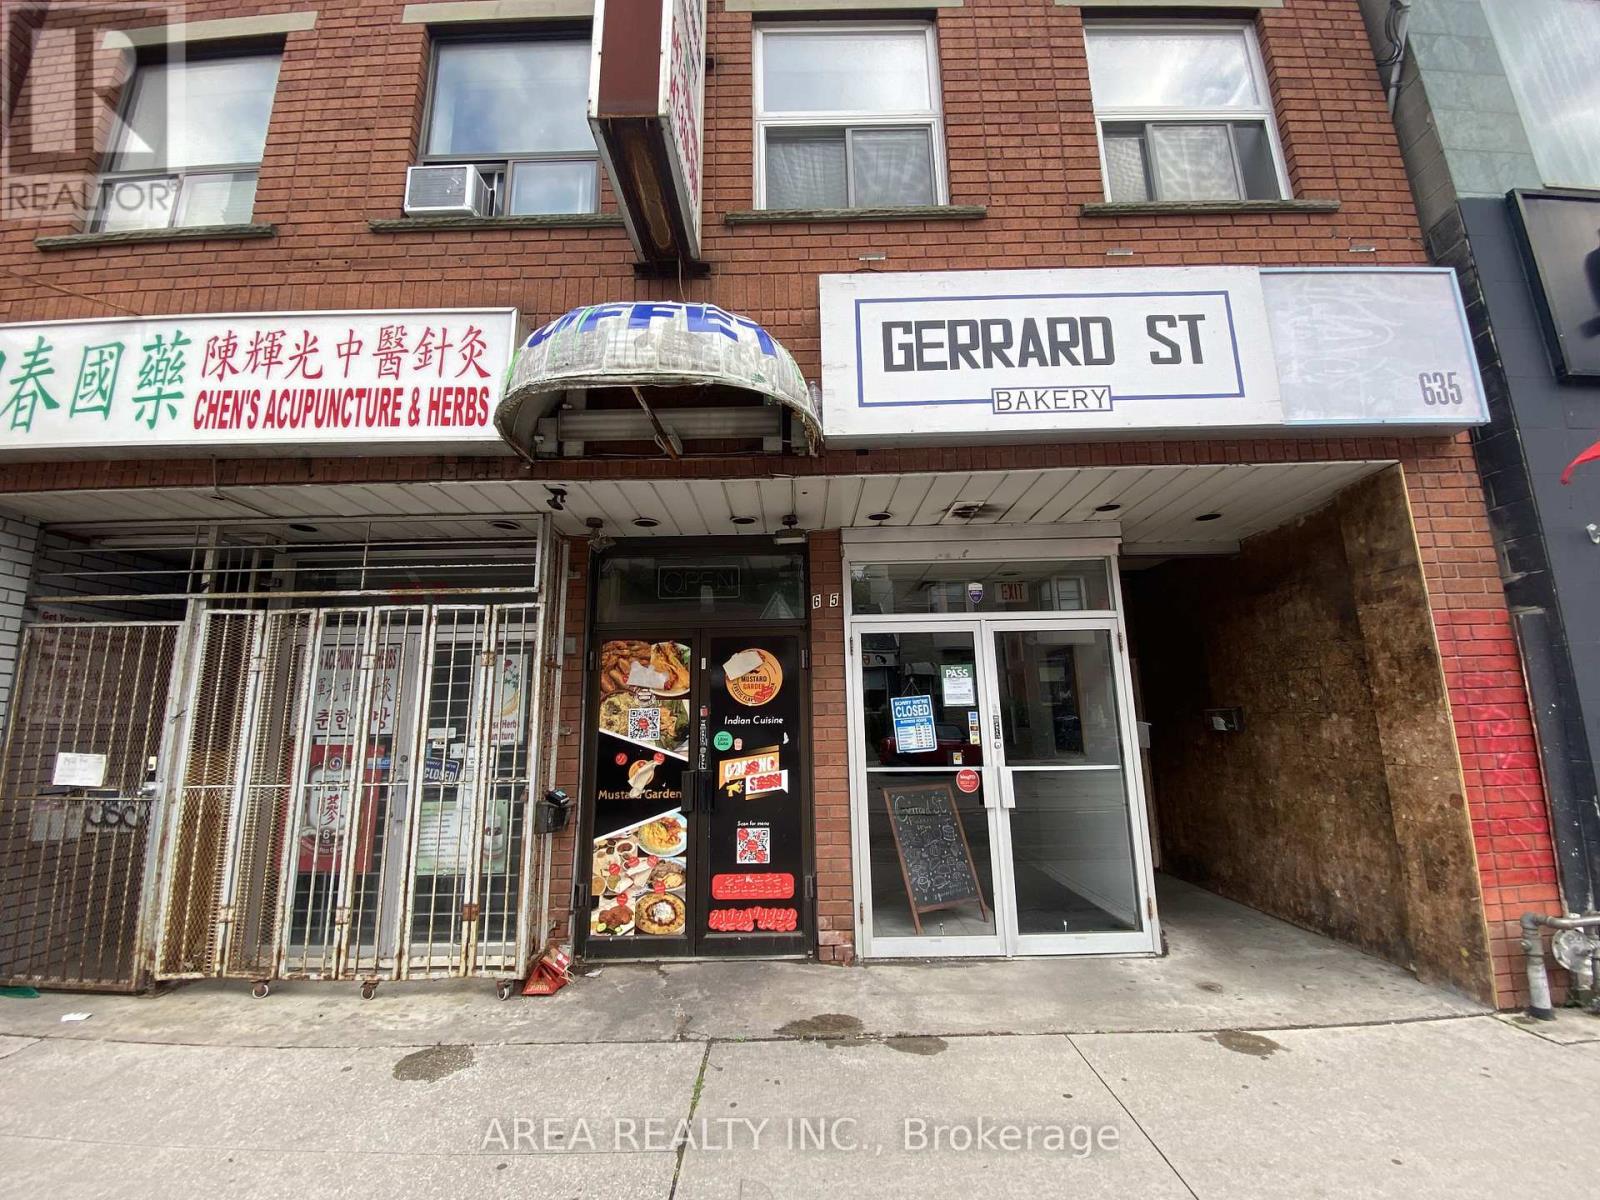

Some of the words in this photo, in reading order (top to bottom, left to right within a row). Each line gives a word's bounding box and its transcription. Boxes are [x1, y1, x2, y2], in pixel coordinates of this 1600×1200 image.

[201, 324, 491, 382] 陳輝光中醫針灸
[882, 316, 1115, 372] GERRARD
[1146, 314, 1206, 365] ST
[0, 330, 192, 433] 春國藥
[1419, 372, 1463, 405] 635
[193, 389, 261, 430] CHEN'S
[263, 387, 403, 429] ACUPUNCTURE
[407, 387, 421, 428] &
[427, 386, 490, 428] HERBS
[995, 388, 1108, 411] BAKERY
[1001, 583, 1023, 600] EXIT
[945, 668, 969, 678] PASS
[724, 716, 751, 725] Indian
[753, 715, 784, 725] Cuisine
[895, 704, 930, 718] CLOSED
[424, 768, 455, 783] CLOSED
[598, 789, 642, 800] Musta
[645, 788, 682, 799] Garden
